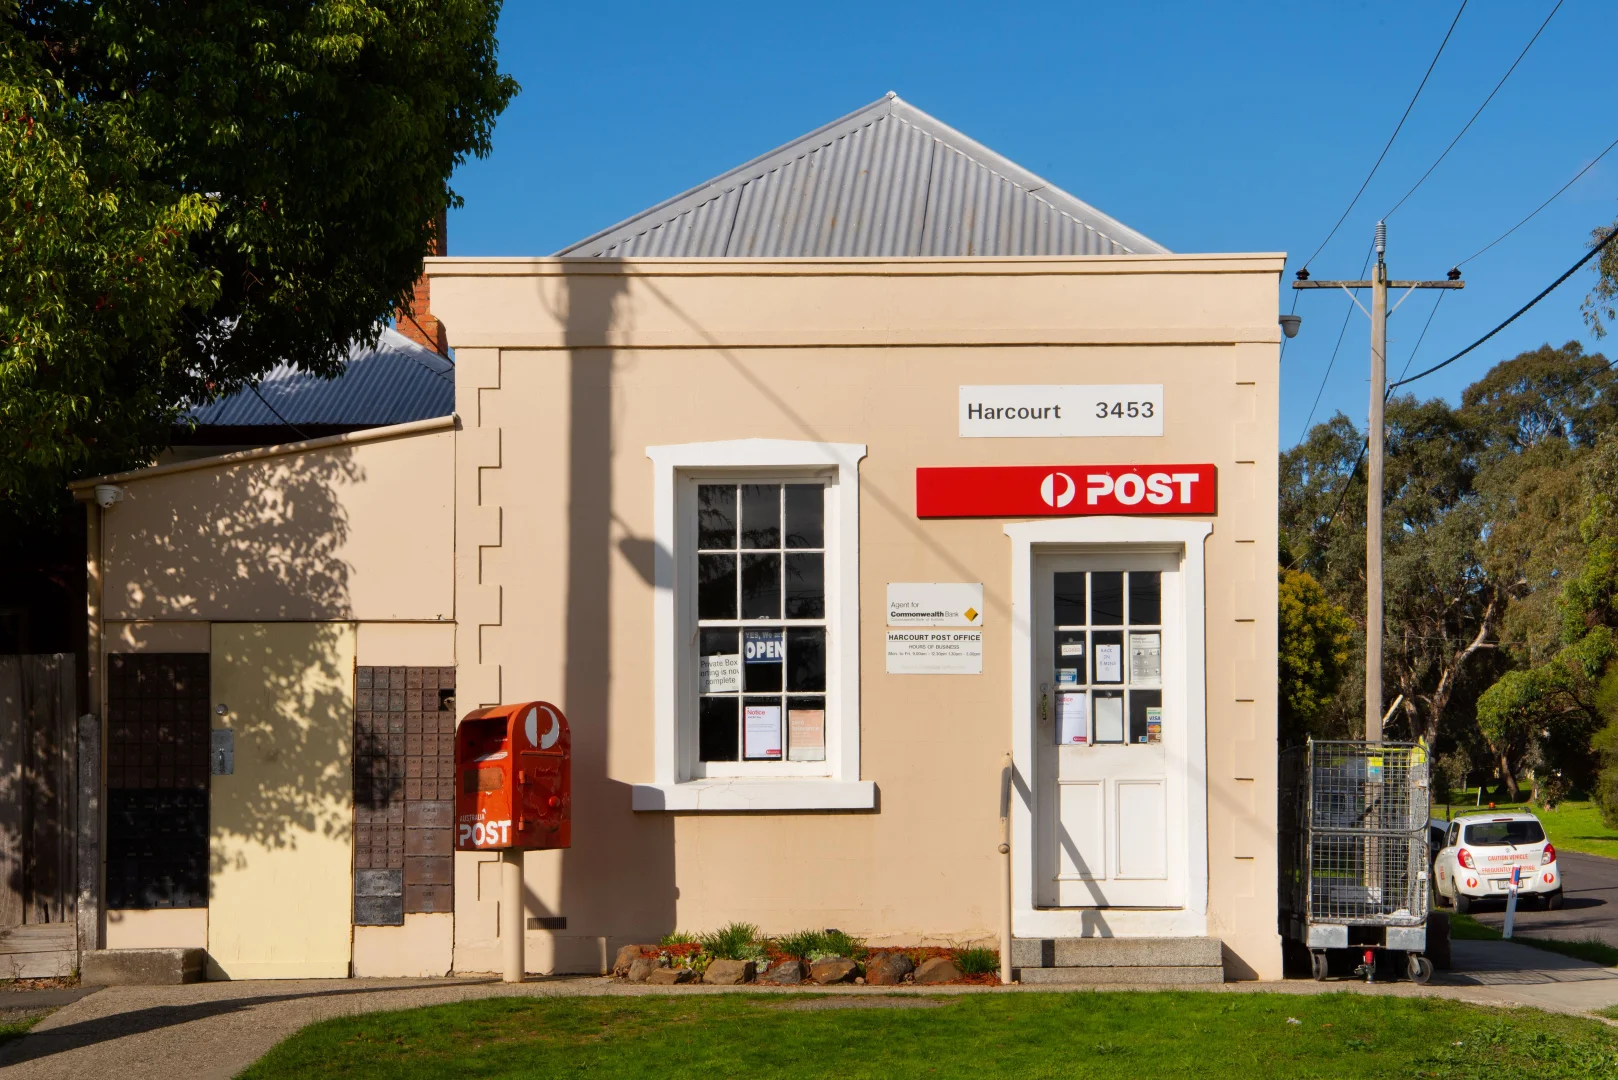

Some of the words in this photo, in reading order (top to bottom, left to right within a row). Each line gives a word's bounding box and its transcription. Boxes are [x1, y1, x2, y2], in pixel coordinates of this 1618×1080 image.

[967, 402, 1062, 420] Harcourt
[1095, 401, 1155, 419] 3453
[1086, 472, 1200, 506] POST
[891, 601, 910, 609] Agent
[745, 632, 761, 640] YES,
[745, 641, 783, 659] OPEN
[724, 658, 738, 666] Box
[700, 669, 719, 677] orting
[705, 677, 736, 686] complete
[459, 813, 485, 822] AUSTRALIA
[459, 819, 512, 847] POST
[1487, 854, 1509, 862] CAUTION
